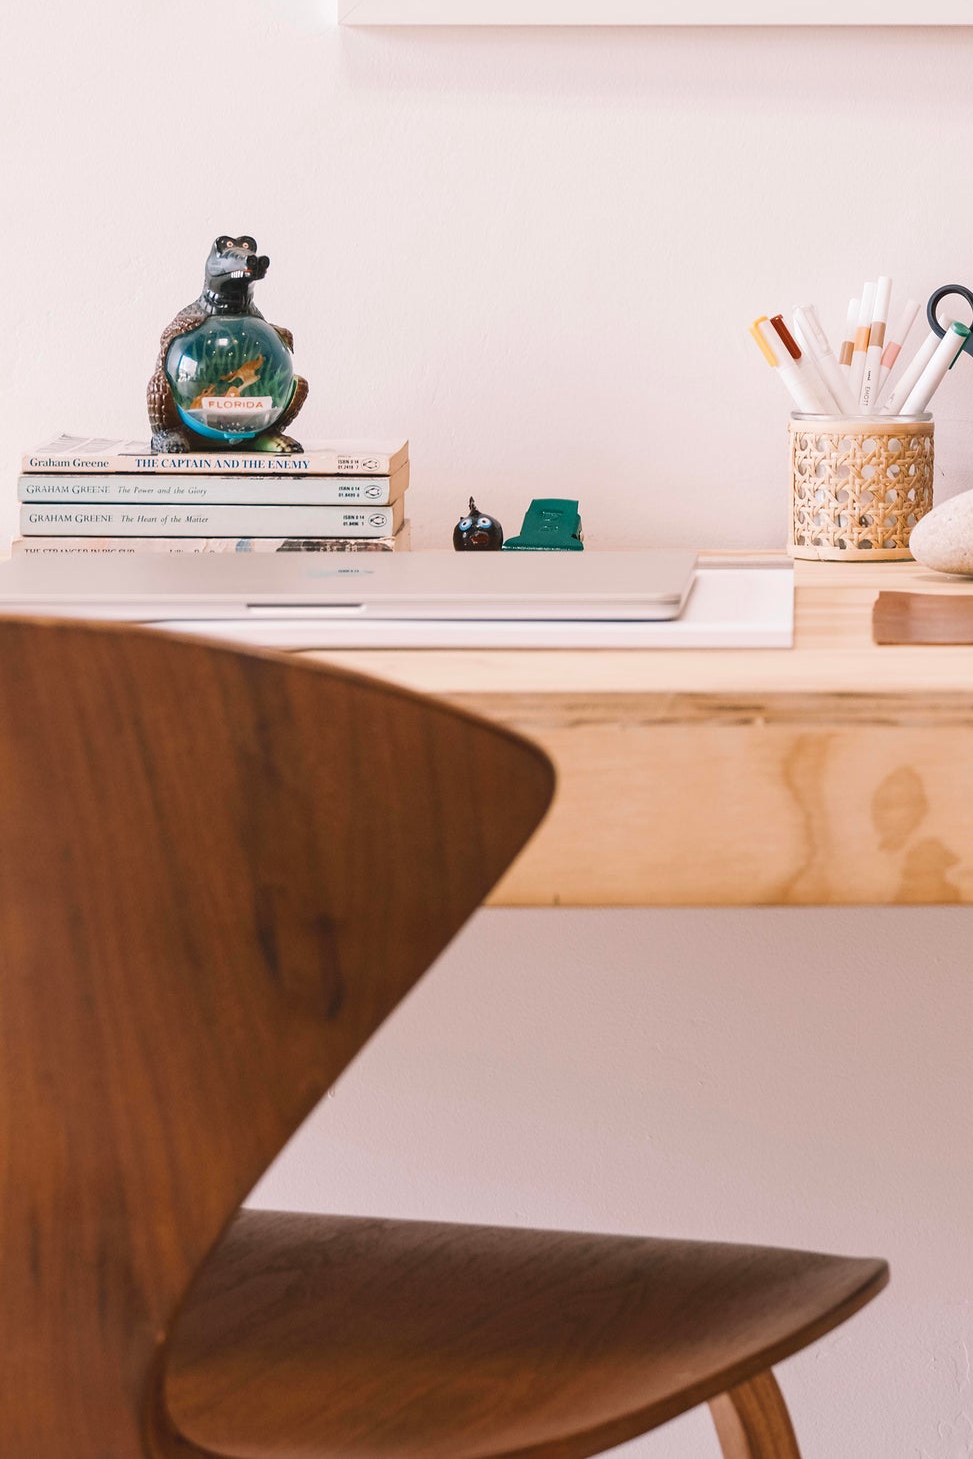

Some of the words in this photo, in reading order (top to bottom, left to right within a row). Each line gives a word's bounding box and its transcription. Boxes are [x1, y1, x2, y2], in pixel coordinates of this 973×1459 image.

[208, 400, 264, 409] FLORIDA
[29, 457, 71, 468] Graham
[72, 457, 109, 468] Greene
[135, 459, 159, 468] THE
[161, 459, 212, 468] CAPTAIN
[214, 459, 240, 468] AND
[242, 459, 266, 469] THE
[267, 459, 311, 469] ENEMY
[26, 485, 70, 494] GRAHAM
[71, 485, 110, 494] GREENE
[134, 486, 154, 494] Power
[157, 486, 171, 494] and
[174, 486, 185, 494] the
[188, 486, 207, 497] Glory
[29, 514, 72, 523] GRAHAM
[74, 514, 113, 523] GREENE
[121, 515, 134, 523] The
[137, 515, 158, 523] Heart
[160, 515, 169, 525] of
[171, 515, 182, 523] the
[186, 515, 209, 524] Matter
